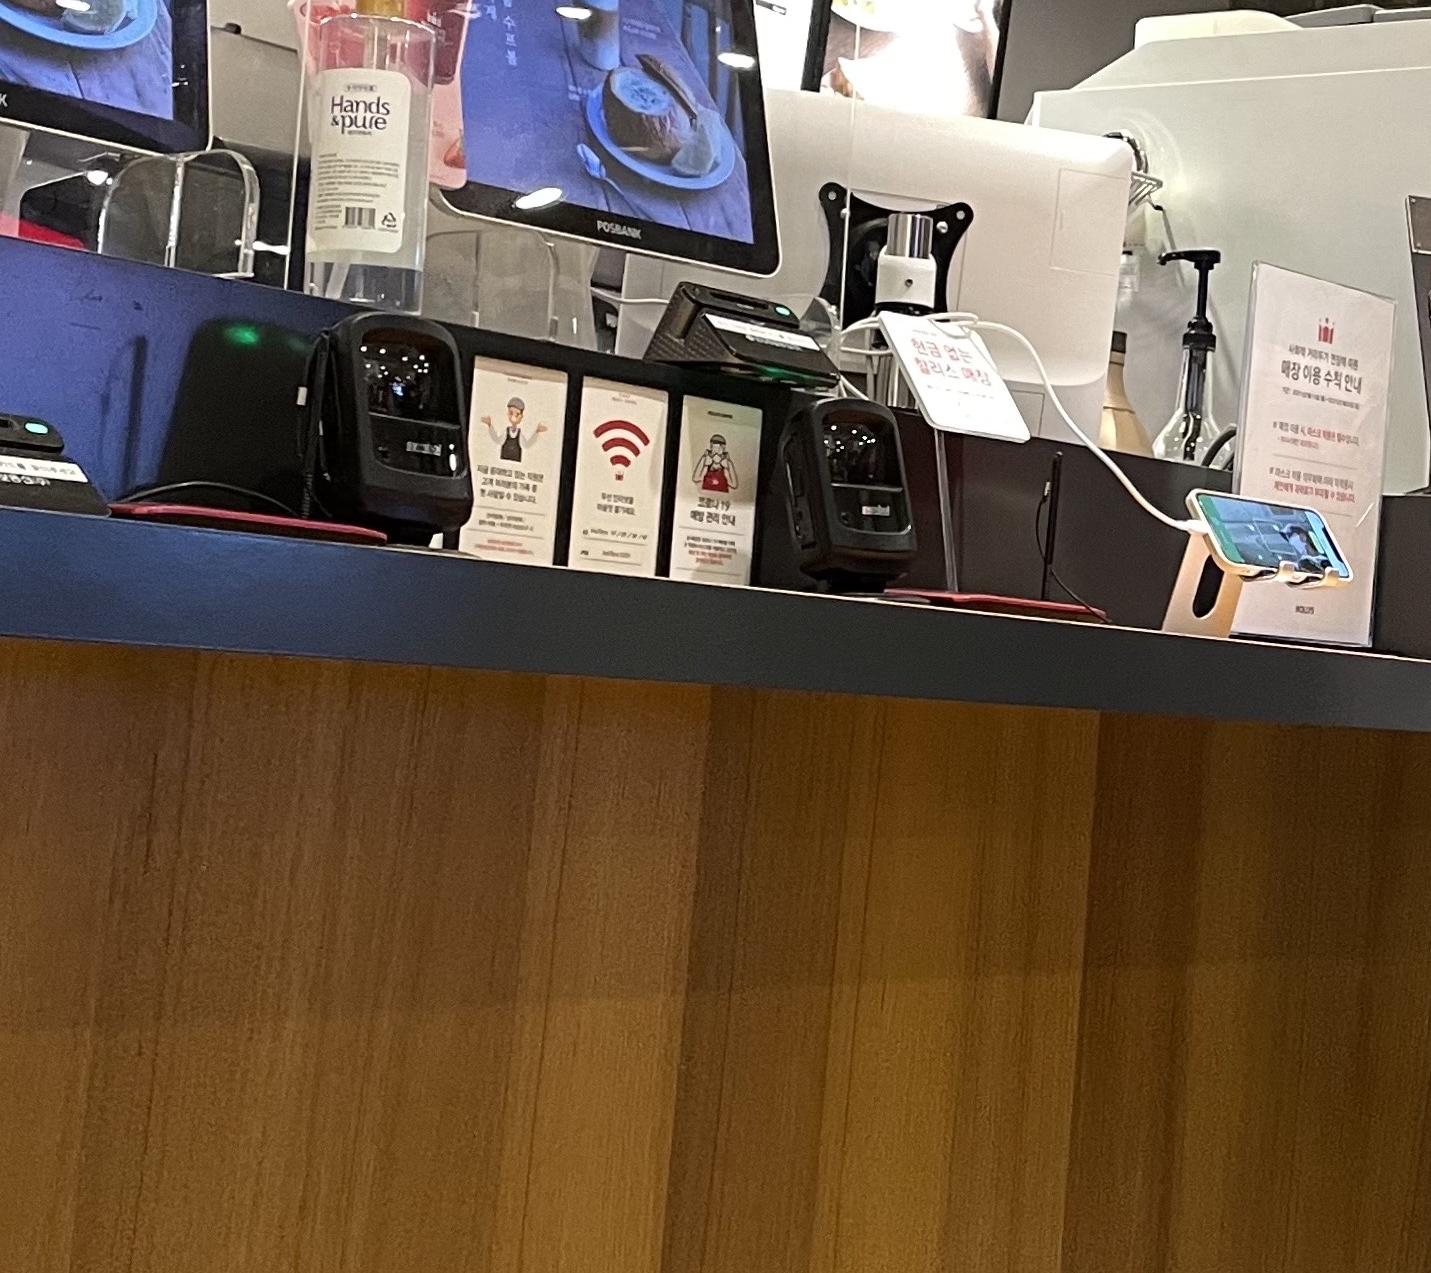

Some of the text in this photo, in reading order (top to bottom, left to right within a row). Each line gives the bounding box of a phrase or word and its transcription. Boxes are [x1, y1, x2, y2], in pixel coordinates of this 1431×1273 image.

[330, 95, 390, 116] Hands
[596, 220, 642, 240] POSBANK
[911, 338, 973, 364] 현금 없는
[914, 357, 992, 387] 할리스 매장
[1281, 360, 1362, 395] 매장 이용 수칙 안내
[721, 513, 737, 527] 안내
